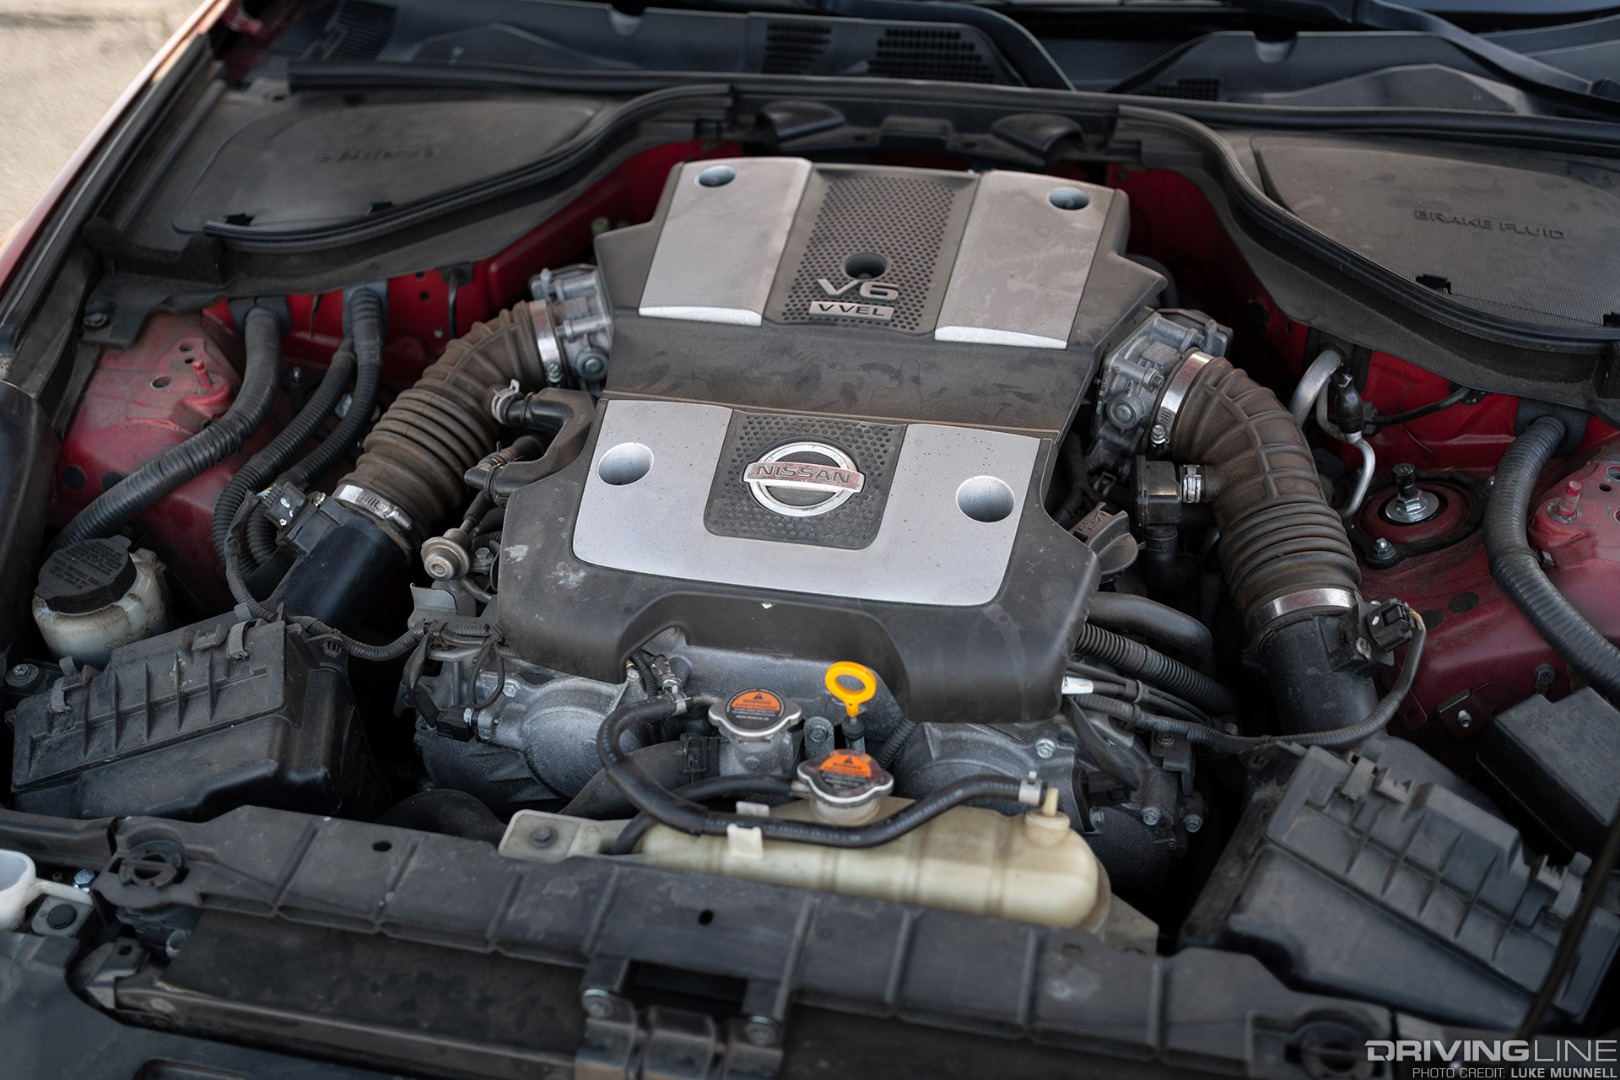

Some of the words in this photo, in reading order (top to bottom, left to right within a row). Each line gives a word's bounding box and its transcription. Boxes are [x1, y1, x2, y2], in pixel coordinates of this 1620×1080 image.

[1414, 209, 1494, 230] BRAKE
[1499, 221, 1567, 240] FLUID
[817, 279, 899, 300] V6
[818, 303, 885, 317] VVEL
[757, 465, 850, 484] NISSAN
